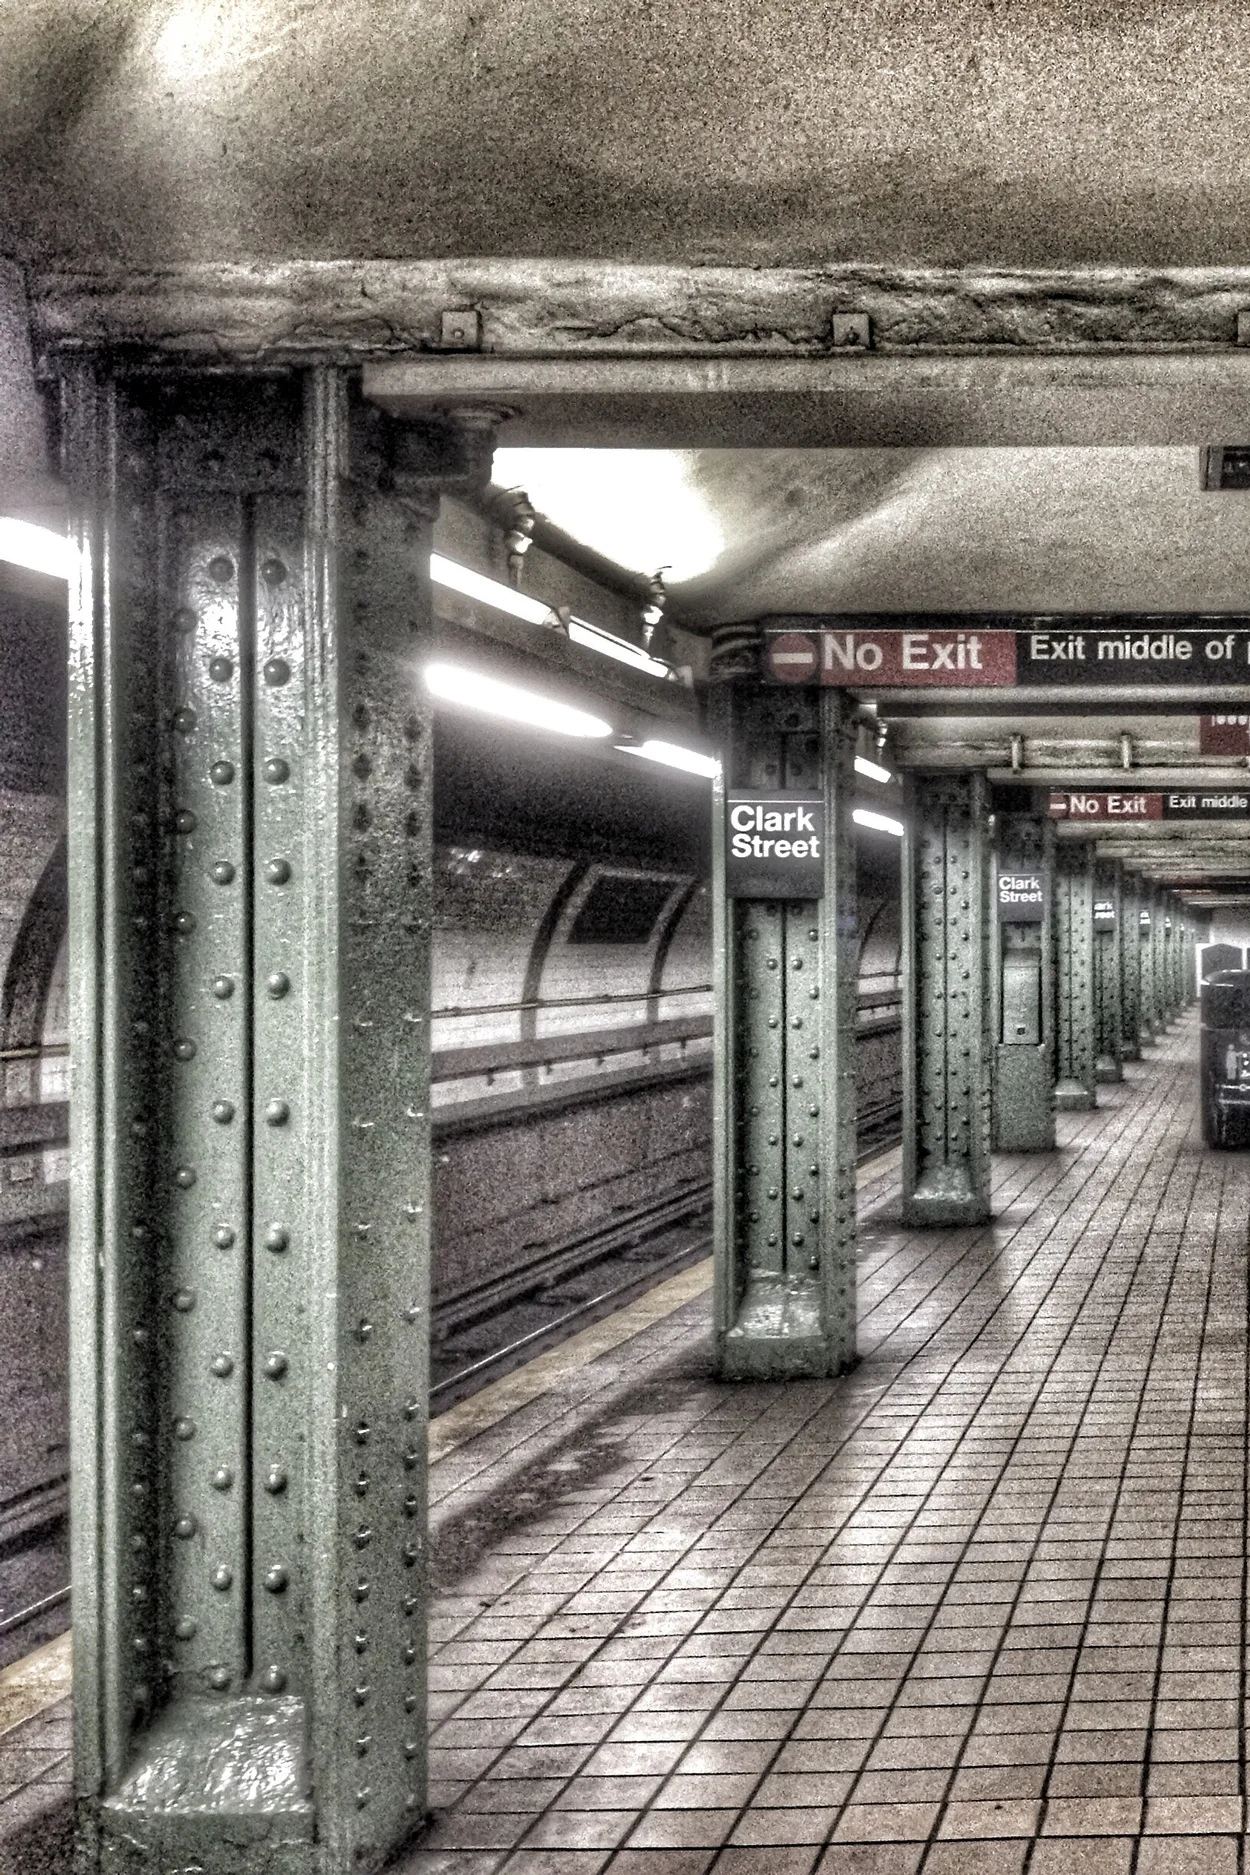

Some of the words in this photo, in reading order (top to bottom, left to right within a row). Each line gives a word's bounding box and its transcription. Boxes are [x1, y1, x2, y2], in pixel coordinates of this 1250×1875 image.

[824, 633, 883, 671] No
[902, 634, 983, 670] Exit
[1030, 634, 1086, 660] Exit
[1098, 634, 1193, 660] middle
[1205, 634, 1235, 660] of
[1070, 796, 1100, 814] No
[1107, 796, 1148, 814] Exit
[1169, 795, 1197, 808] Exit
[1201, 795, 1248, 808] middle
[730, 805, 815, 832] Clark
[731, 833, 820, 858] Street
[999, 876, 1040, 890] Clark
[1000, 890, 1043, 903] Street
